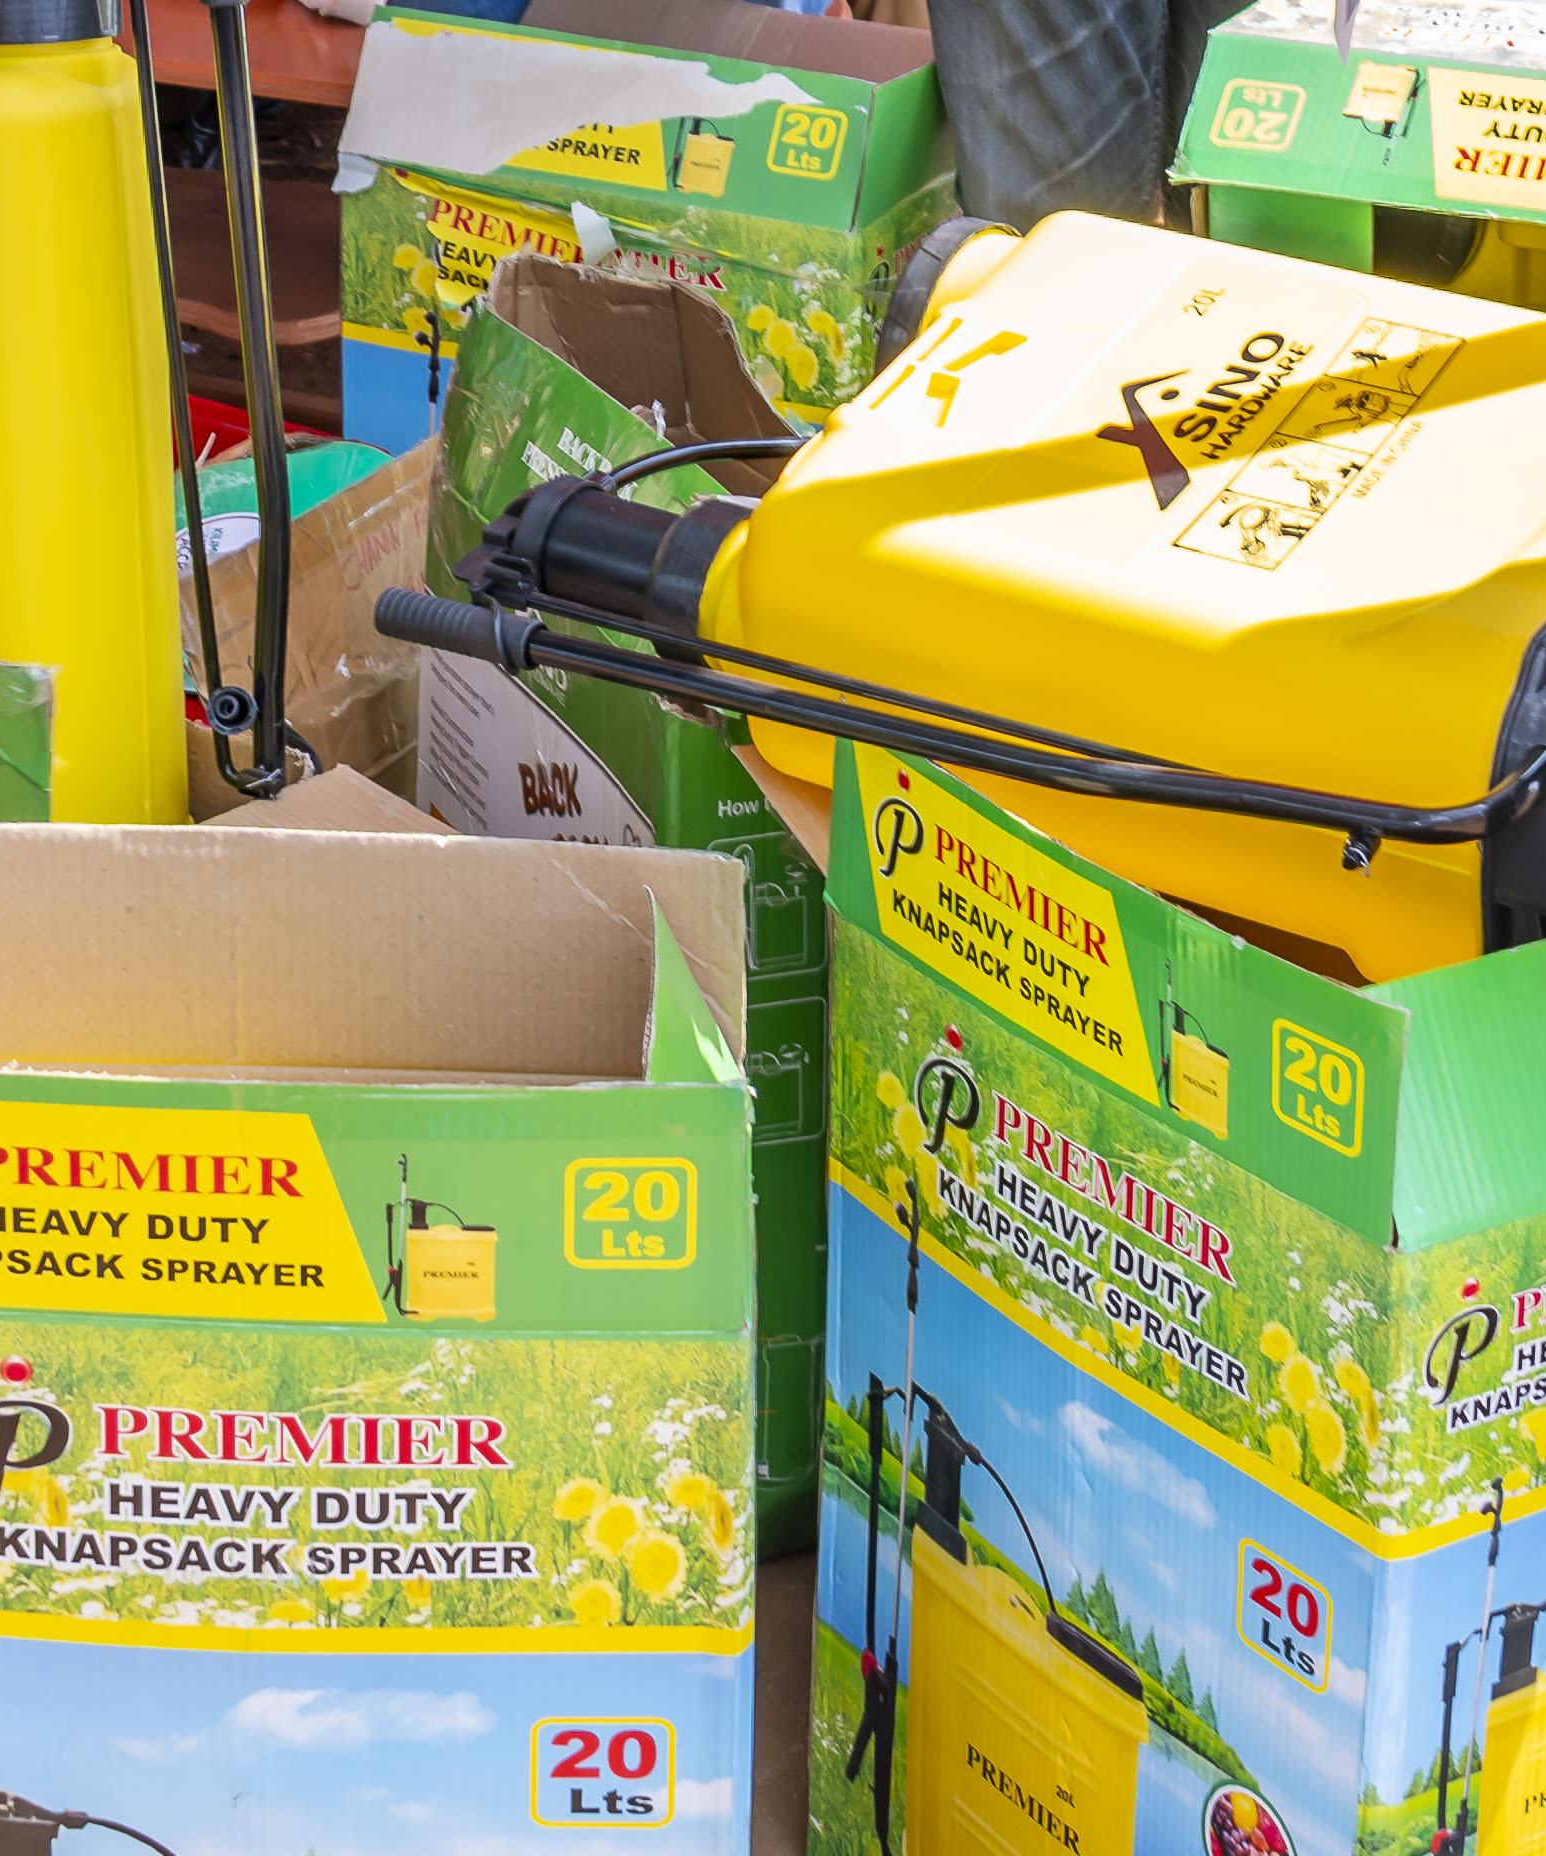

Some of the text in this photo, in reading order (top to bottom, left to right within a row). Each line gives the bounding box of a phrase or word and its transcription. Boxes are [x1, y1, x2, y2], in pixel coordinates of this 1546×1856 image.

[781, 113, 837, 150] 20
[1222, 107, 1288, 143] 20
[547, 138, 641, 165] SPRAYER
[786, 149, 822, 171] Lts
[1183, 286, 1225, 318] 20L
[1173, 331, 1286, 444] SINO
[1200, 340, 1315, 460] HARDWARE
[517, 761, 582, 818] BACK
[717, 799, 760, 818] How
[933, 823, 1111, 968] PREMIER
[938, 880, 1092, 1000] HEAVY DUTY
[891, 892, 1124, 1058] KNAPSACK SPRAYER
[1284, 1035, 1352, 1109] 20
[1297, 1092, 1342, 1140] Lts
[582, 1170, 681, 1222] 20
[992, 1090, 1237, 1287] PREMIER
[146, 1213, 270, 1245] DUTY
[602, 1228, 666, 1258] Lts
[995, 1161, 1210, 1328] HEAVY DUTY
[140, 1257, 325, 1288] SPRAYER
[937, 1163, 1250, 1402] KNAPSACK SPRAYER
[93, 1403, 514, 1470] PREMIER
[106, 1481, 470, 1530] HEAVY DUTY
[307, 1541, 537, 1579] SPRAYER
[1249, 1557, 1320, 1640] 20
[1261, 1618, 1316, 1678] Lts
[549, 1729, 659, 1780] 20
[568, 1786, 656, 1816] Lts
[966, 1742, 1081, 1856] PREMIER
